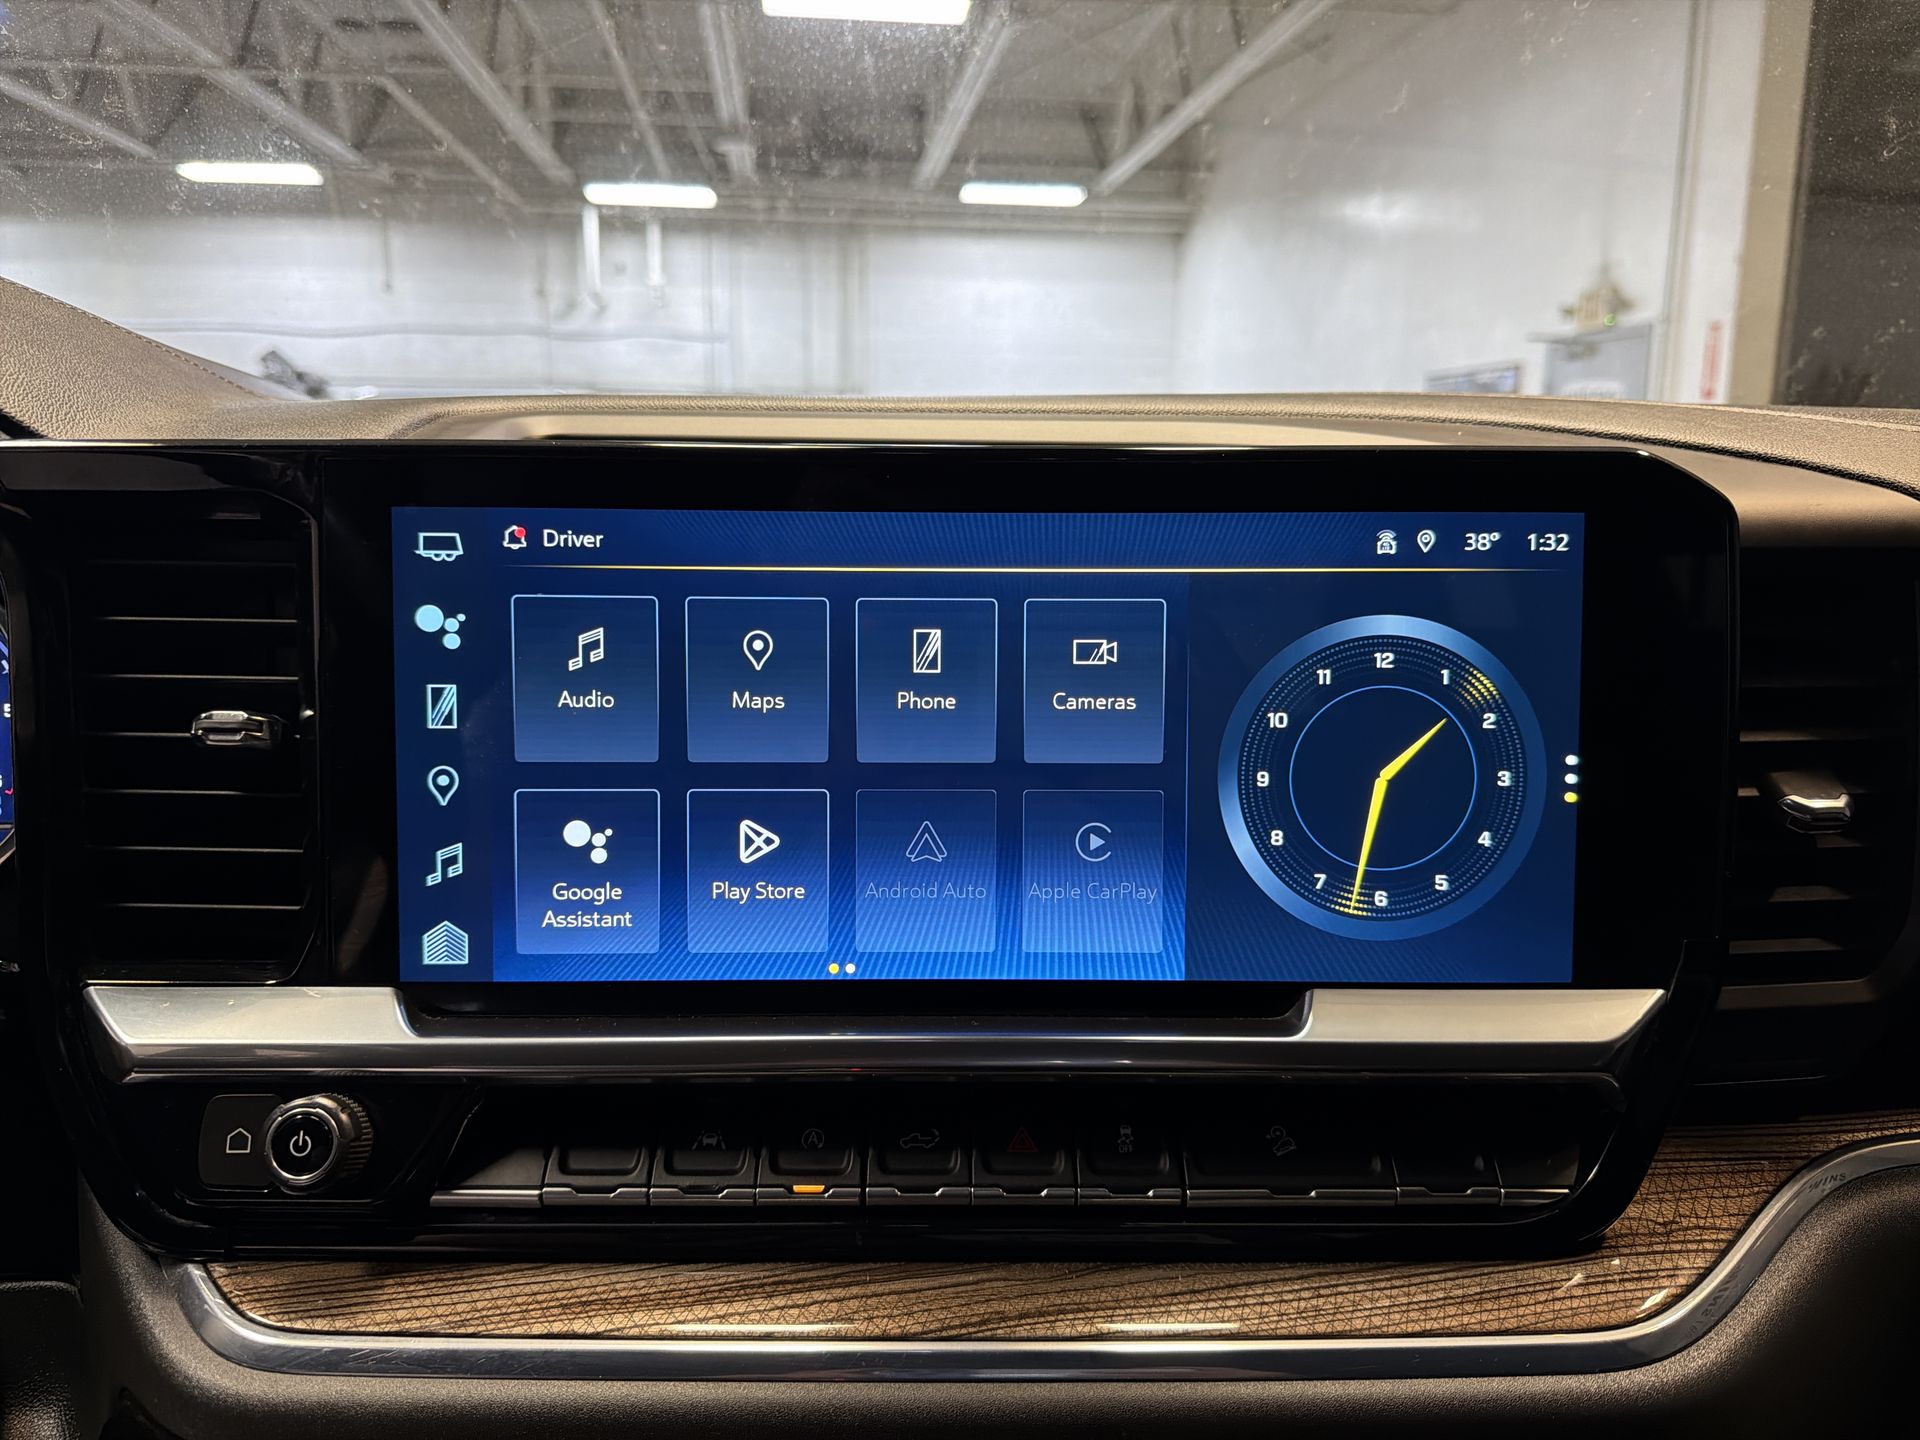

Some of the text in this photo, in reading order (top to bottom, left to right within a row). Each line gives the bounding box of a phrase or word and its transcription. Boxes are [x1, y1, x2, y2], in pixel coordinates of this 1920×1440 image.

[542, 528, 604, 548] Driver
[1464, 531, 1501, 551] 38°
[1527, 533, 1570, 552] 1:32
[1373, 652, 1395, 669] 12
[1316, 668, 1331, 685] 11
[1440, 669, 1450, 685] 1
[557, 689, 615, 708] Audio
[732, 690, 785, 714] Maps
[897, 690, 957, 710] Phone
[1052, 692, 1137, 711] Cameras
[1267, 712, 1288, 729] 10
[1482, 712, 1497, 729] 2
[1256, 771, 1270, 787] 9
[1497, 770, 1511, 787] 3
[1270, 829, 1284, 846] 8
[1477, 831, 1493, 848] 4
[864, 881, 987, 900] Android Auto
[1313, 873, 1327, 890] 7
[1434, 874, 1449, 891] 5
[552, 881, 623, 906] Google
[712, 881, 806, 905] Play Store
[1028, 881, 1158, 905] Apple CarPlay
[1373, 890, 1389, 908] 6
[541, 910, 633, 929] Assistant
